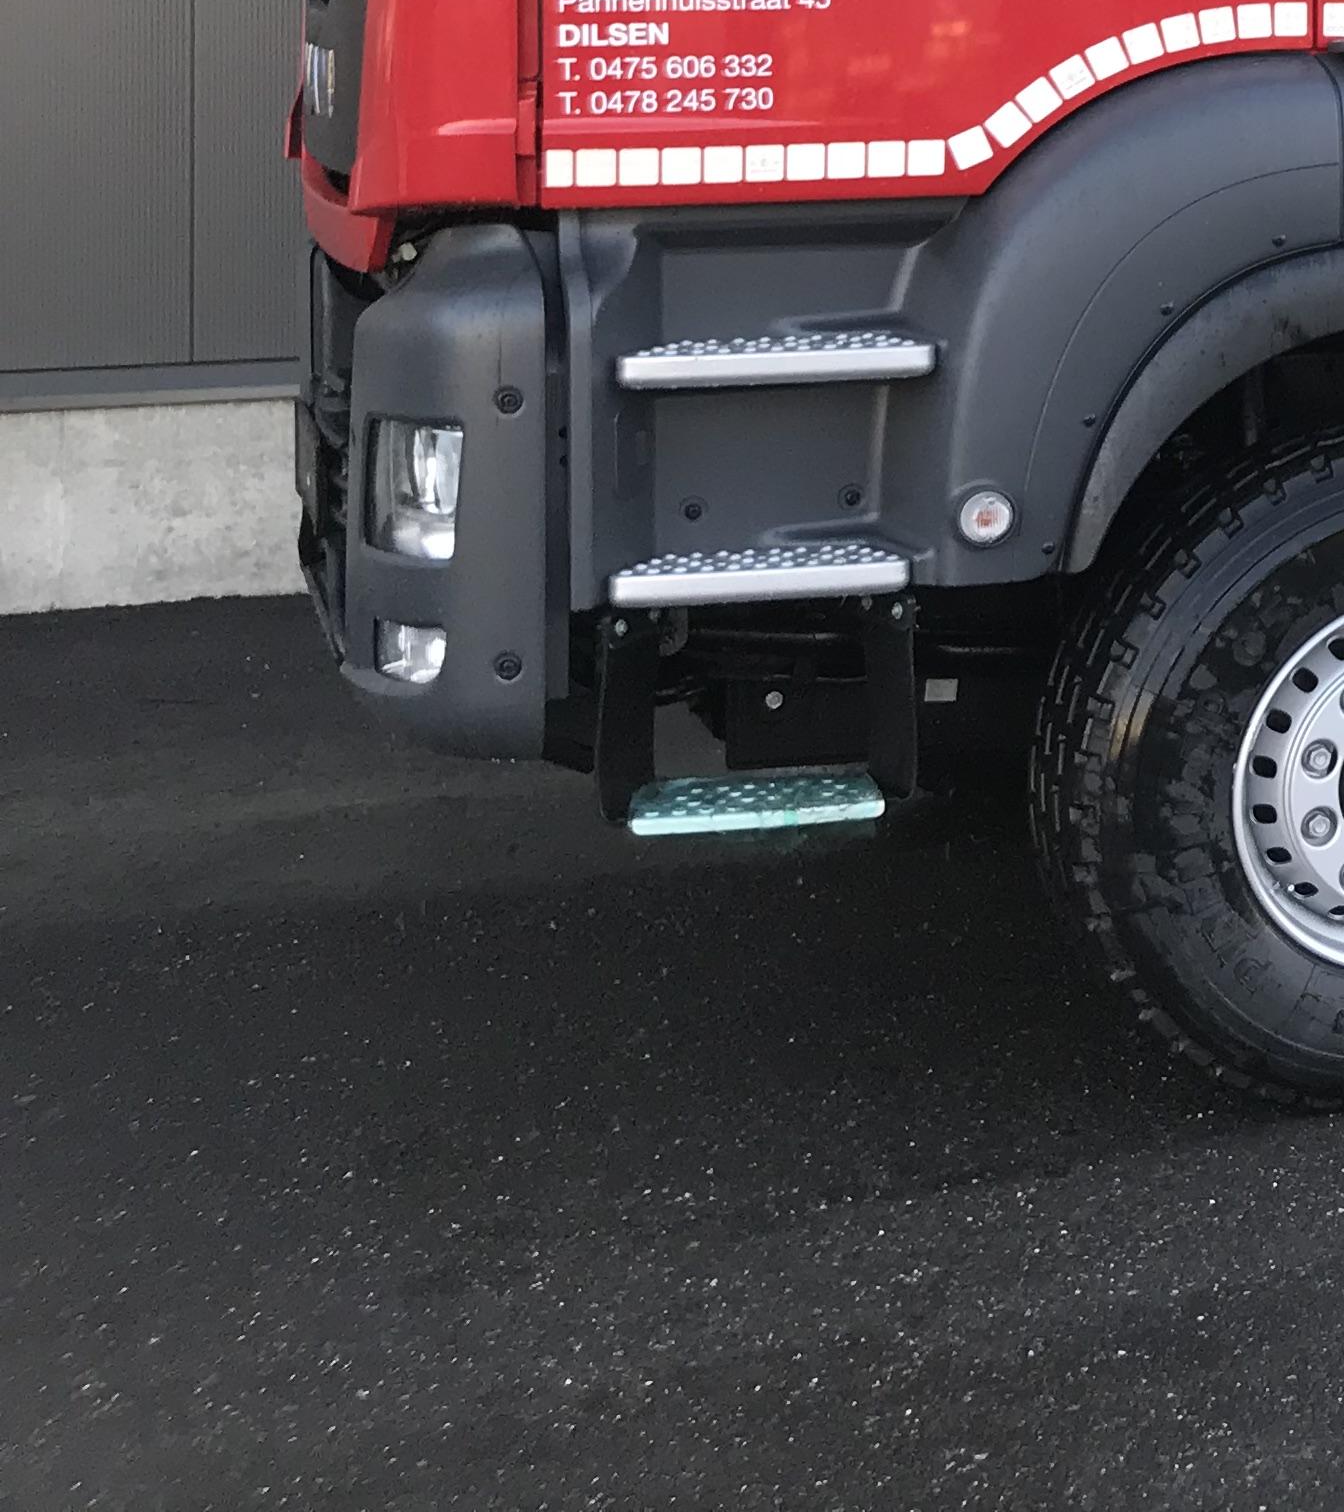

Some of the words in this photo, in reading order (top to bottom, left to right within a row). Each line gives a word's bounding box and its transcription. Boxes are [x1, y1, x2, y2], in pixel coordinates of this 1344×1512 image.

[559, 23, 670, 48] DILSEN
[558, 58, 580, 81] T.
[590, 57, 658, 81] 0475
[666, 56, 716, 79] 606
[725, 54, 773, 77] 332
[558, 91, 580, 115] T.
[590, 90, 658, 115] 0478
[666, 89, 716, 112] 245
[725, 88, 773, 110] 730
